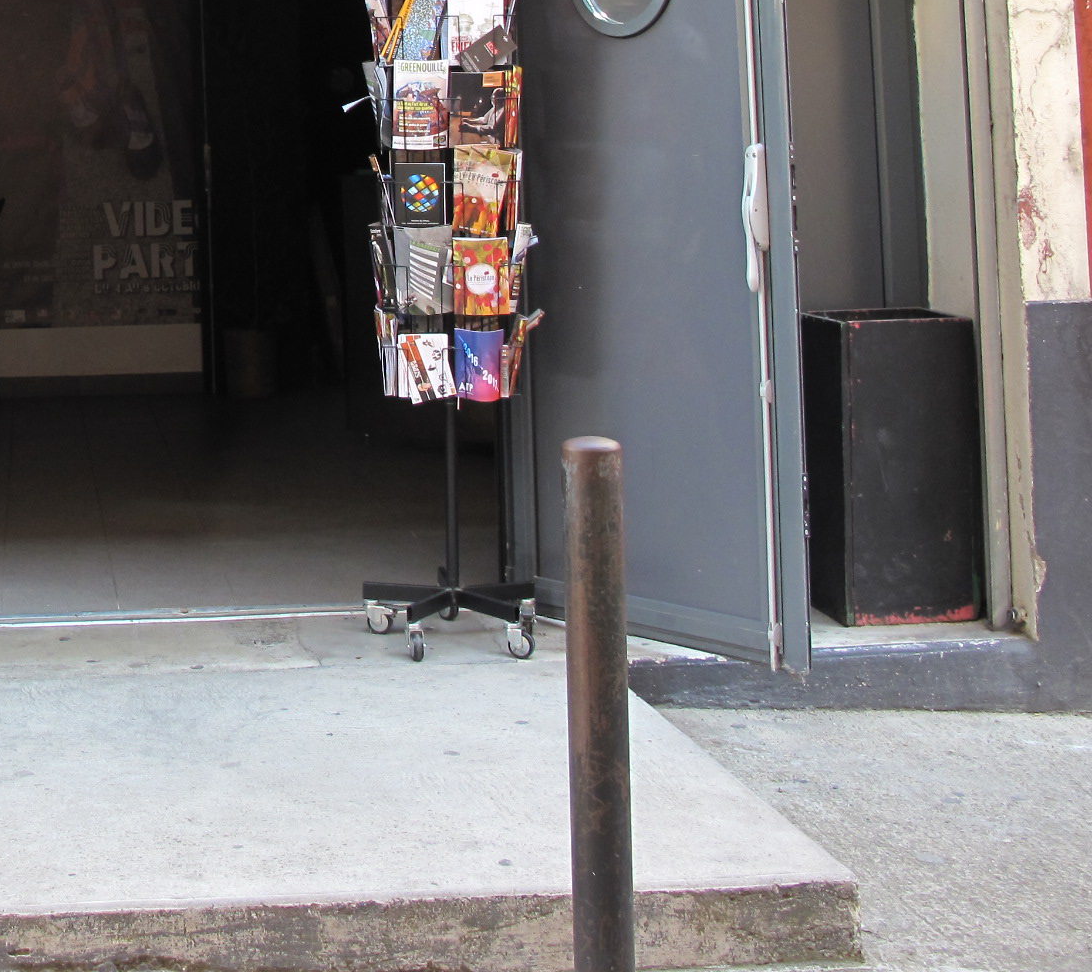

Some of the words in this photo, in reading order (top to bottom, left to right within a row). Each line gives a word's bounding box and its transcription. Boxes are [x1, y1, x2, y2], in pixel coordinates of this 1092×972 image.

[400, 62, 444, 73] GREENOUILLE
[102, 199, 198, 237] VIDE
[93, 241, 200, 280] PART
[463, 343, 479, 367] 2016
